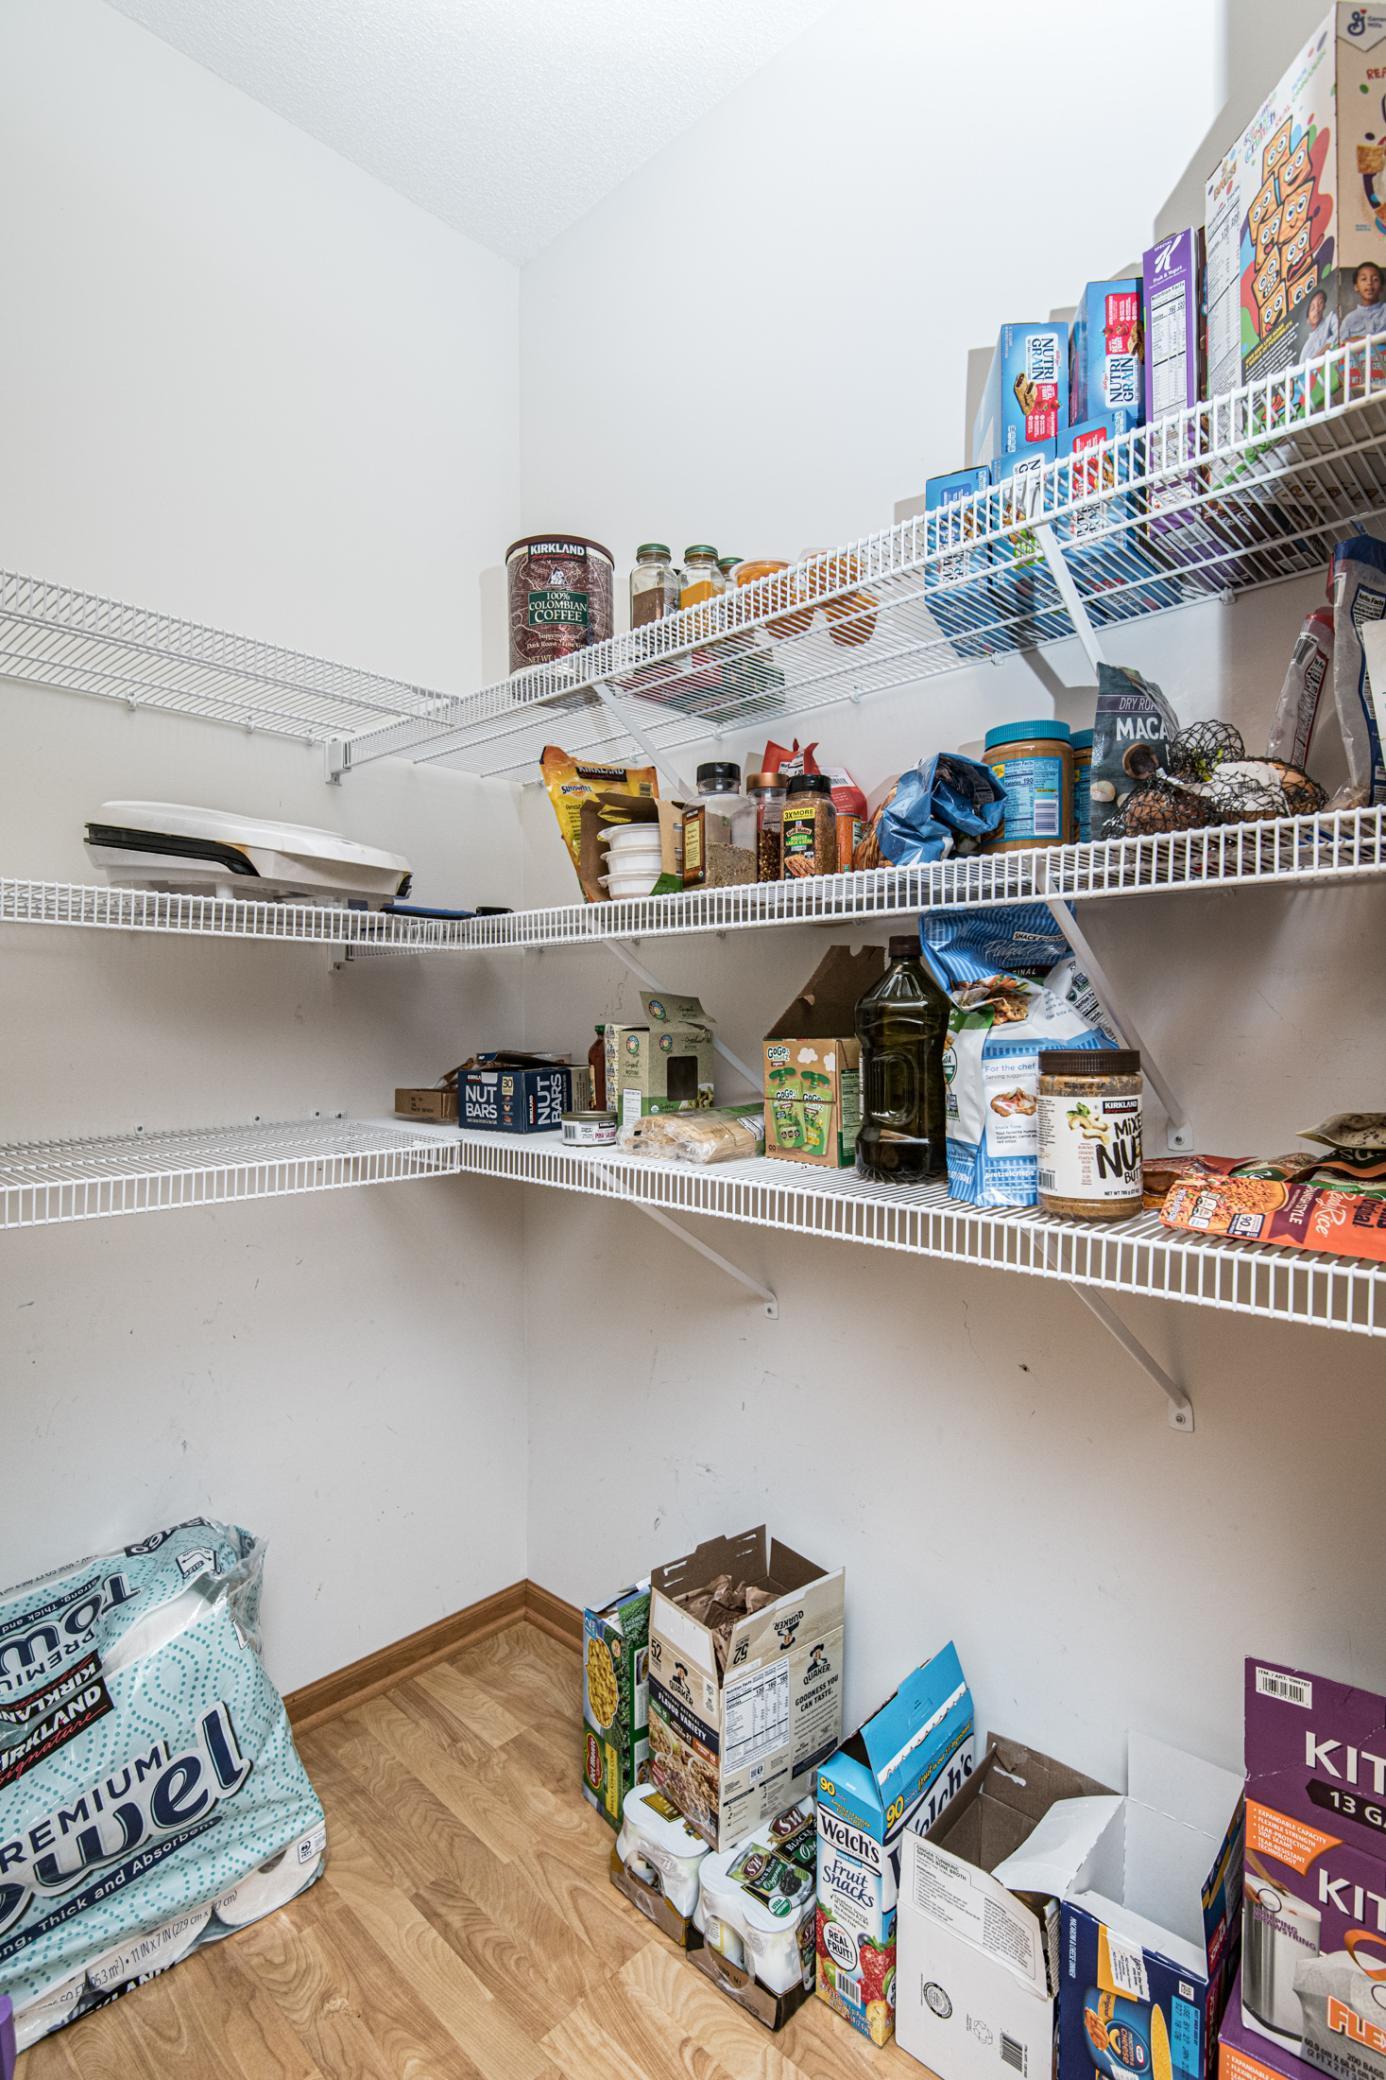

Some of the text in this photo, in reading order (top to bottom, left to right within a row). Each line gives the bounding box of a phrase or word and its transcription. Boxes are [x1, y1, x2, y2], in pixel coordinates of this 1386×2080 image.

[1154, 235, 1184, 274] K
[1031, 337, 1045, 381] GRAIN
[1042, 337, 1055, 385] NUTRI
[1109, 358, 1123, 403] NUTRI
[1123, 357, 1134, 402] GRAIN
[530, 543, 585, 556] KIRKLAND
[528, 600, 587, 612] COLOMBIAN
[546, 592, 570, 601] 100%
[534, 609, 583, 623] COFFEE
[1119, 697, 1137, 711] DRY
[784, 808, 814, 820] 3X MORE
[1014, 932, 1036, 941] SNACK
[985, 1065, 1000, 1073] For
[1017, 1062, 1036, 1071] chef
[465, 1085, 497, 1103] NUT
[502, 1078, 513, 1088] 30
[537, 1076, 551, 1125] NUT
[550, 1073, 562, 1123] BARS
[1104, 1100, 1137, 1109] KIRKLAND
[465, 1103, 498, 1119] BARS
[1314, 1204, 1347, 1238] Rice
[28, 1602, 59, 1623] Thick
[773, 1610, 804, 1631] QUAKER
[0, 1617, 25, 1634] and
[650, 1638, 662, 1663] 52
[733, 1643, 749, 1665] 52
[803, 1663, 832, 1686] QUAKER
[669, 1679, 694, 1706] QUAKER
[794, 1674, 839, 1707] GOODNESS YOU
[800, 1689, 834, 1713] CAN TASTE.
[0, 1685, 102, 1772] IRKLAND
[658, 1692, 707, 1741] FLAVOR VARIETY
[1305, 1730, 1386, 1796] KIT
[819, 1776, 836, 1796] 90
[886, 1794, 905, 1829] 90
[1329, 1791, 1356, 1814] 13
[819, 1813, 880, 1864] Welch's
[1257, 1808, 1327, 1845] EXPANDABLE CAPACITY
[1257, 1816, 1316, 1849] FLEXIBLE STRENGTH
[1258, 1829, 1293, 1851] SIDE SEAMS
[1258, 1836, 1305, 1864] TEAR-RESISTANT
[1258, 1842, 1297, 1865] TECHNOLOGY
[38, 1897, 88, 1932] Thick
[94, 1871, 126, 1899] and
[132, 1817, 219, 1875] Absorbent
[832, 1858, 869, 1889] Fruit
[949, 1867, 967, 1881] BROTH
[822, 1865, 875, 1908] Snacks
[1318, 1867, 1386, 1934] KIT
[828, 1928, 849, 1949] REAL
[1069, 1916, 1078, 1940] MACARONI
[827, 1939, 853, 1963] FRUIT!
[1069, 1944, 1077, 1961] CHEESE
[1069, 1960, 1077, 1979] DINNER
[1314, 2051, 1325, 2065] FT
[1340, 2064, 1350, 2077] FT
[1346, 2052, 1384, 2079] 200 BAGS
